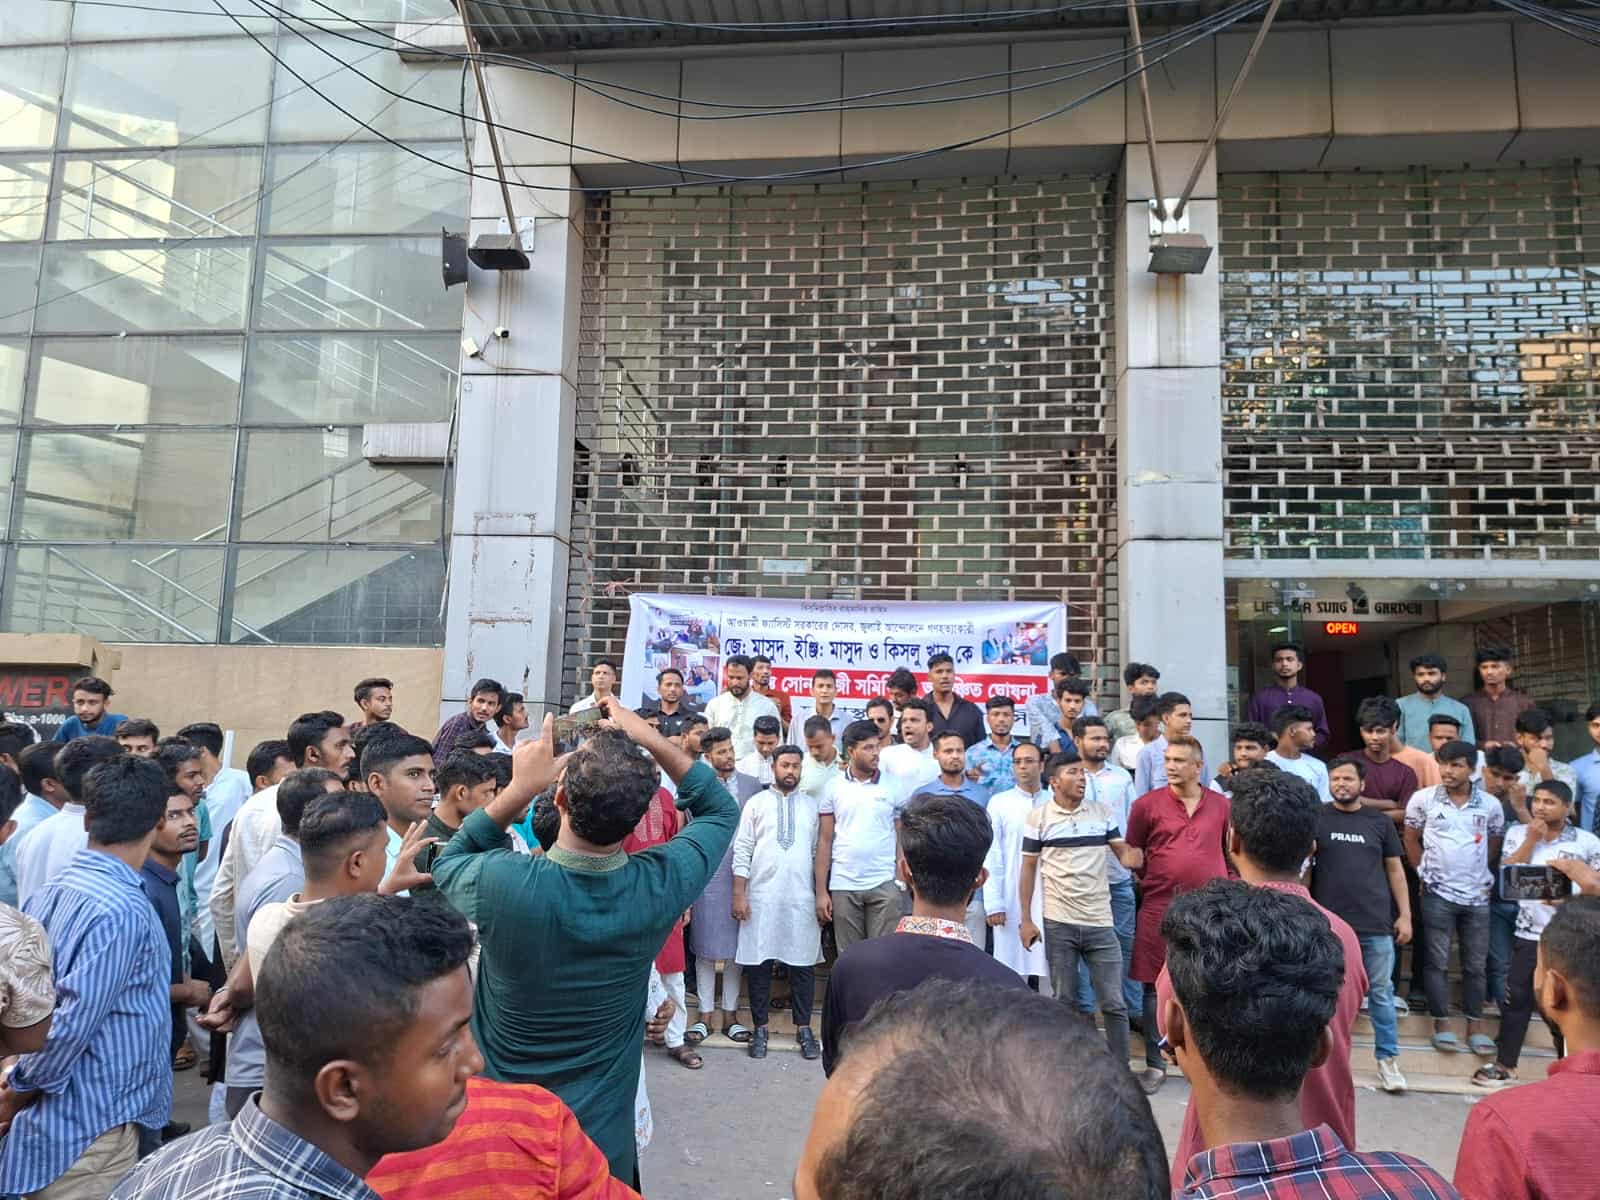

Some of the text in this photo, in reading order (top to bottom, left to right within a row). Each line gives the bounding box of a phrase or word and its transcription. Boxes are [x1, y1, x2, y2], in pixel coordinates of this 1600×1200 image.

[1325, 622, 1358, 634] OPEN
[829, 641, 863, 664] মাসুদ
[869, 643, 879, 660] ও
[956, 645, 975, 663] কে
[1330, 832, 1366, 844] PRADA
